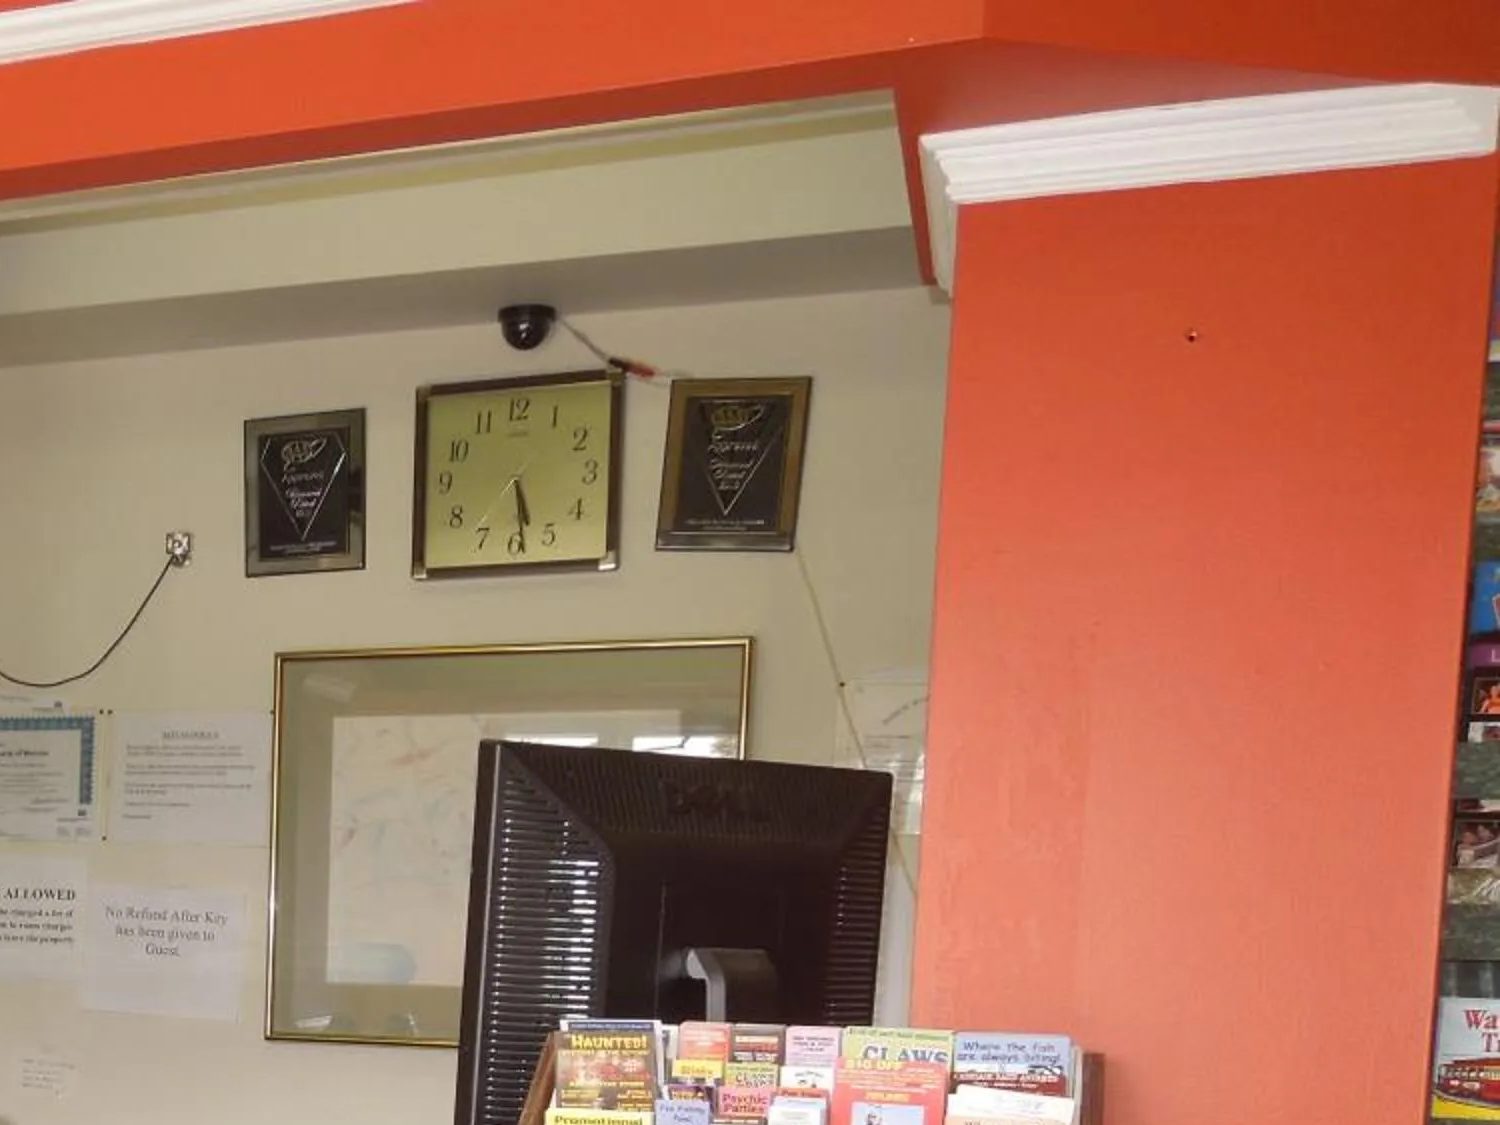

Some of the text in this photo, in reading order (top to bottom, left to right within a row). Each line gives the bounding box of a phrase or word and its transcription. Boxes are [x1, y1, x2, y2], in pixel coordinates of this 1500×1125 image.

[508, 398, 530, 422] 12
[551, 404, 560, 429] 1
[474, 409, 493, 435] 11
[448, 438, 470, 463] 10
[572, 427, 589, 452] 2
[438, 471, 453, 495] 9
[581, 459, 599, 485] 3
[449, 505, 464, 529] 8
[567, 497, 588, 521] 4
[474, 526, 490, 550] 7
[507, 531, 525, 556] 6
[541, 523, 557, 546] 5
[3, 887, 76, 901] ALLOWED
[105, 905, 228, 926] No Refund After Key
[115, 925, 215, 942] has been given to
[1462, 1008, 1500, 1030] Wa
[571, 1033, 648, 1050] HAUNTED!
[963, 1039, 1001, 1051] Where
[1482, 1031, 1500, 1053] T
[957, 1052, 976, 1061] are
[981, 1050, 1019, 1064] always
[723, 1093, 768, 1105] Psychic
[724, 1103, 764, 1113] Parties
